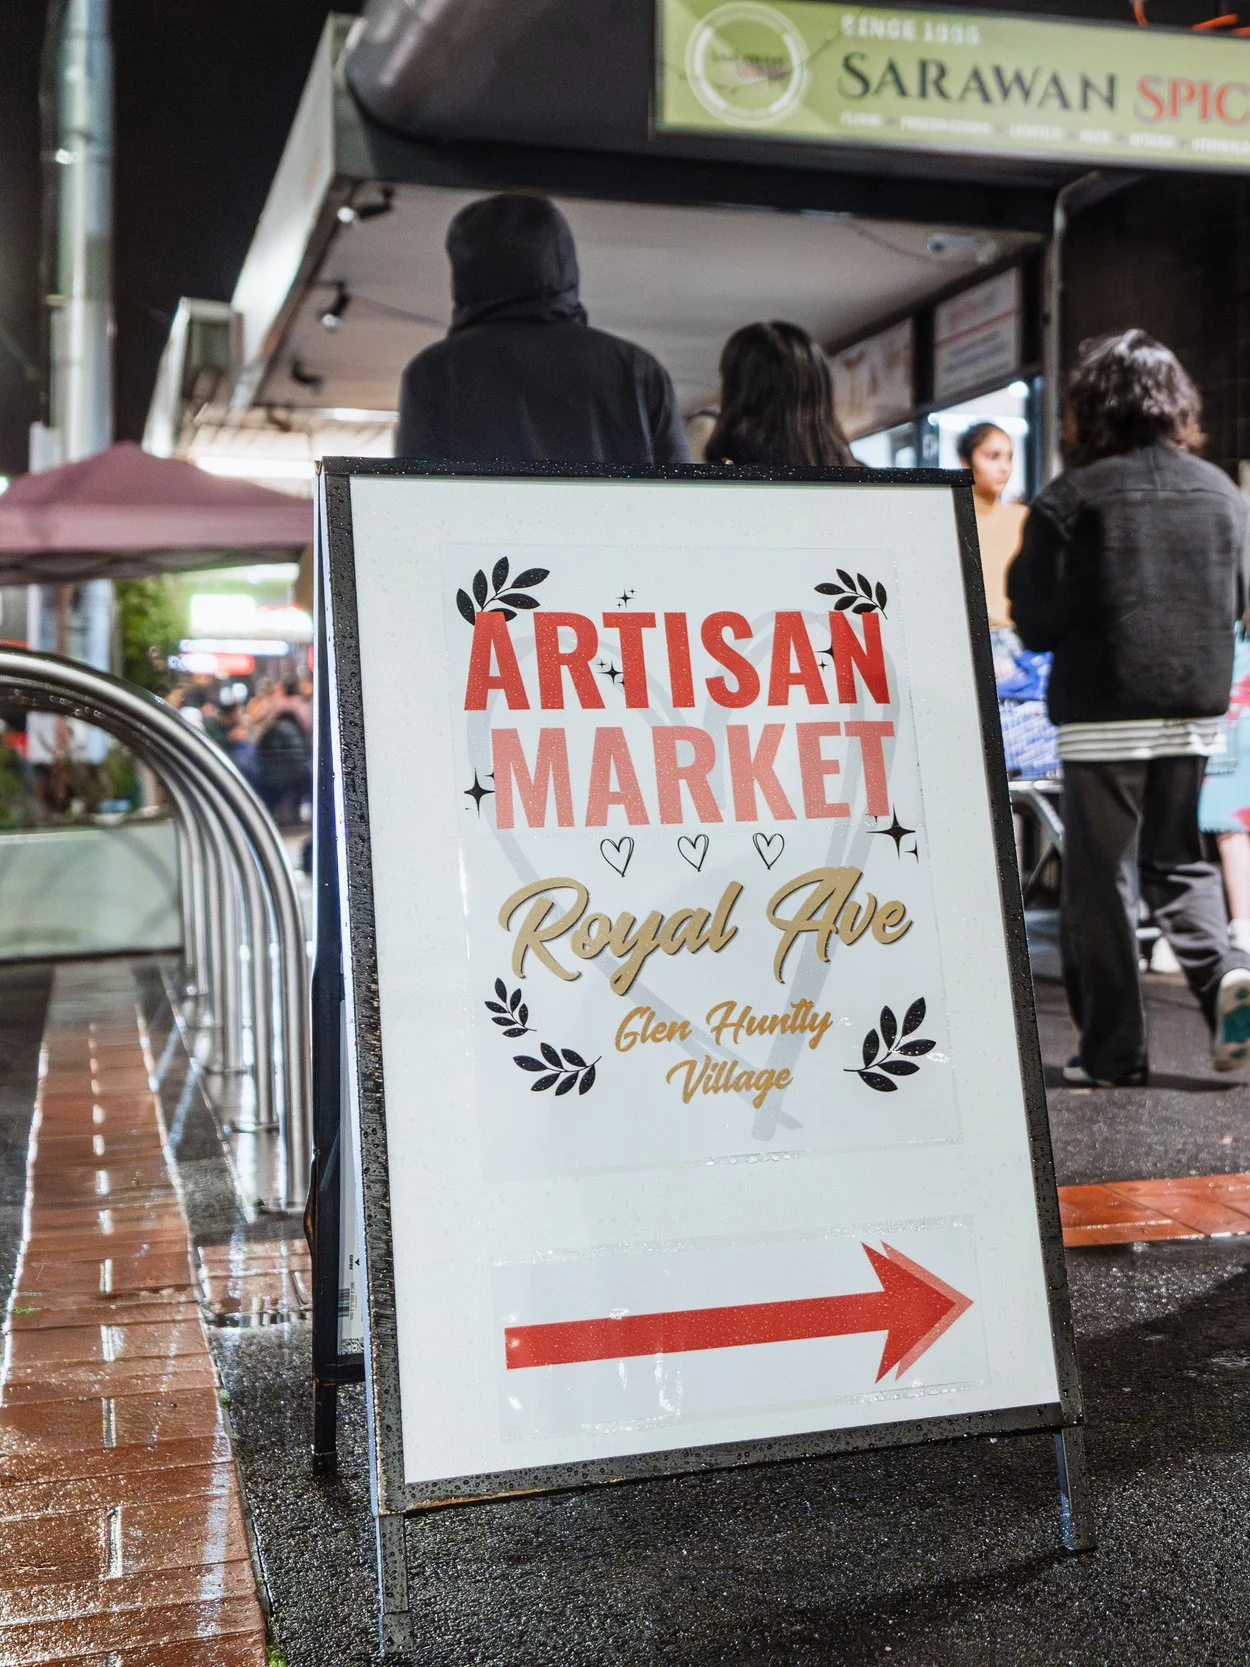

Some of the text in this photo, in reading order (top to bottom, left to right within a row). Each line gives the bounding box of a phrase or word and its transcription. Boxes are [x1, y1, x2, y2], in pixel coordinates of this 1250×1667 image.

[841, 14, 916, 42] SINCE
[837, 51, 1117, 112] SARAWAN
[464, 610, 891, 711] ARTISAN
[491, 720, 895, 829] MARKET
[498, 867, 913, 996] Royal Ave
[615, 998, 833, 1052] Glen Huntly
[665, 1055, 793, 1109] Village
